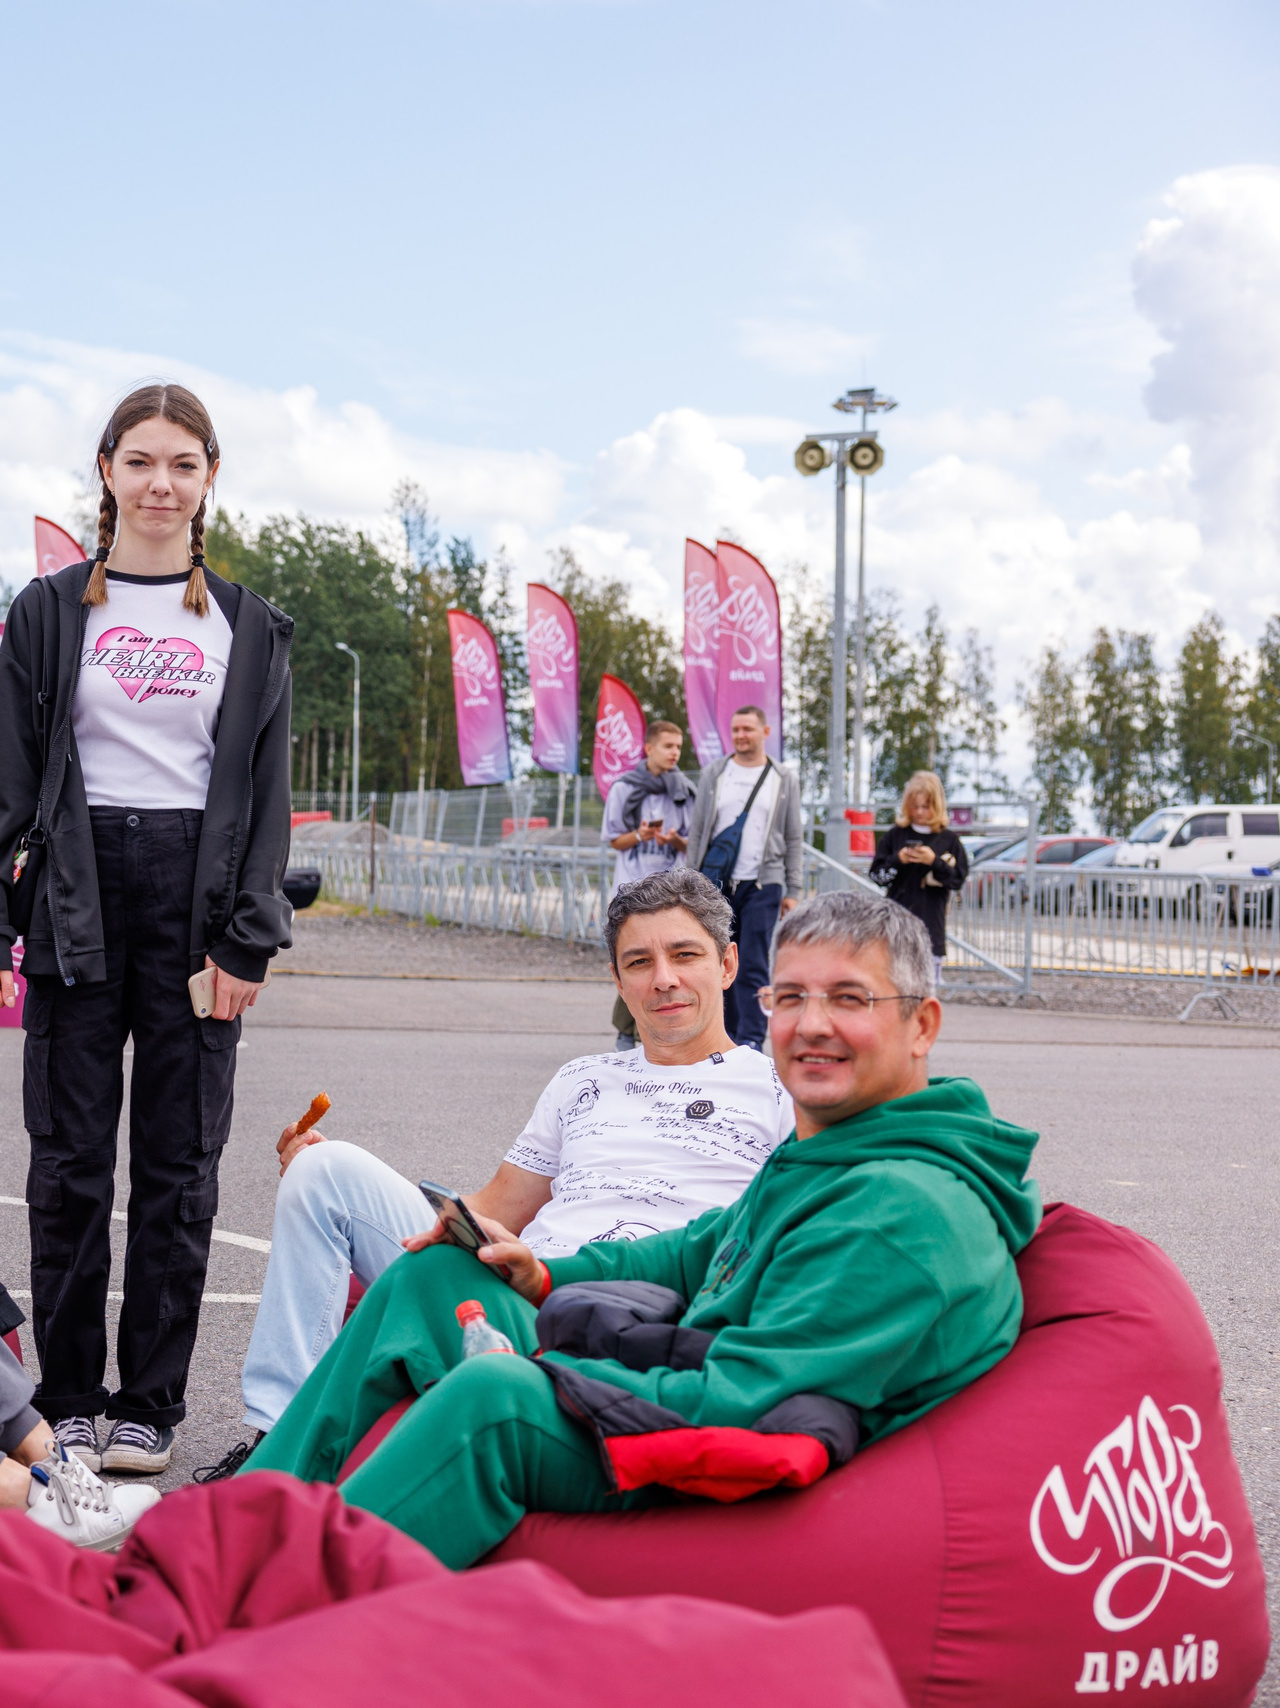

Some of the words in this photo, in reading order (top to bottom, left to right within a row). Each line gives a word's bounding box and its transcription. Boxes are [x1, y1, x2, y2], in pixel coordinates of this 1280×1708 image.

[117, 634, 126, 643] I
[128, 636, 153, 644] am
[81, 648, 196, 669] HEART
[112, 667, 217, 685] BREAKER
[145, 685, 202, 699] honey
[624, 1080, 665, 1098] Philipp
[668, 1081, 703, 1096] Plein
[1074, 1633, 1220, 1694] ДРАЙВ
